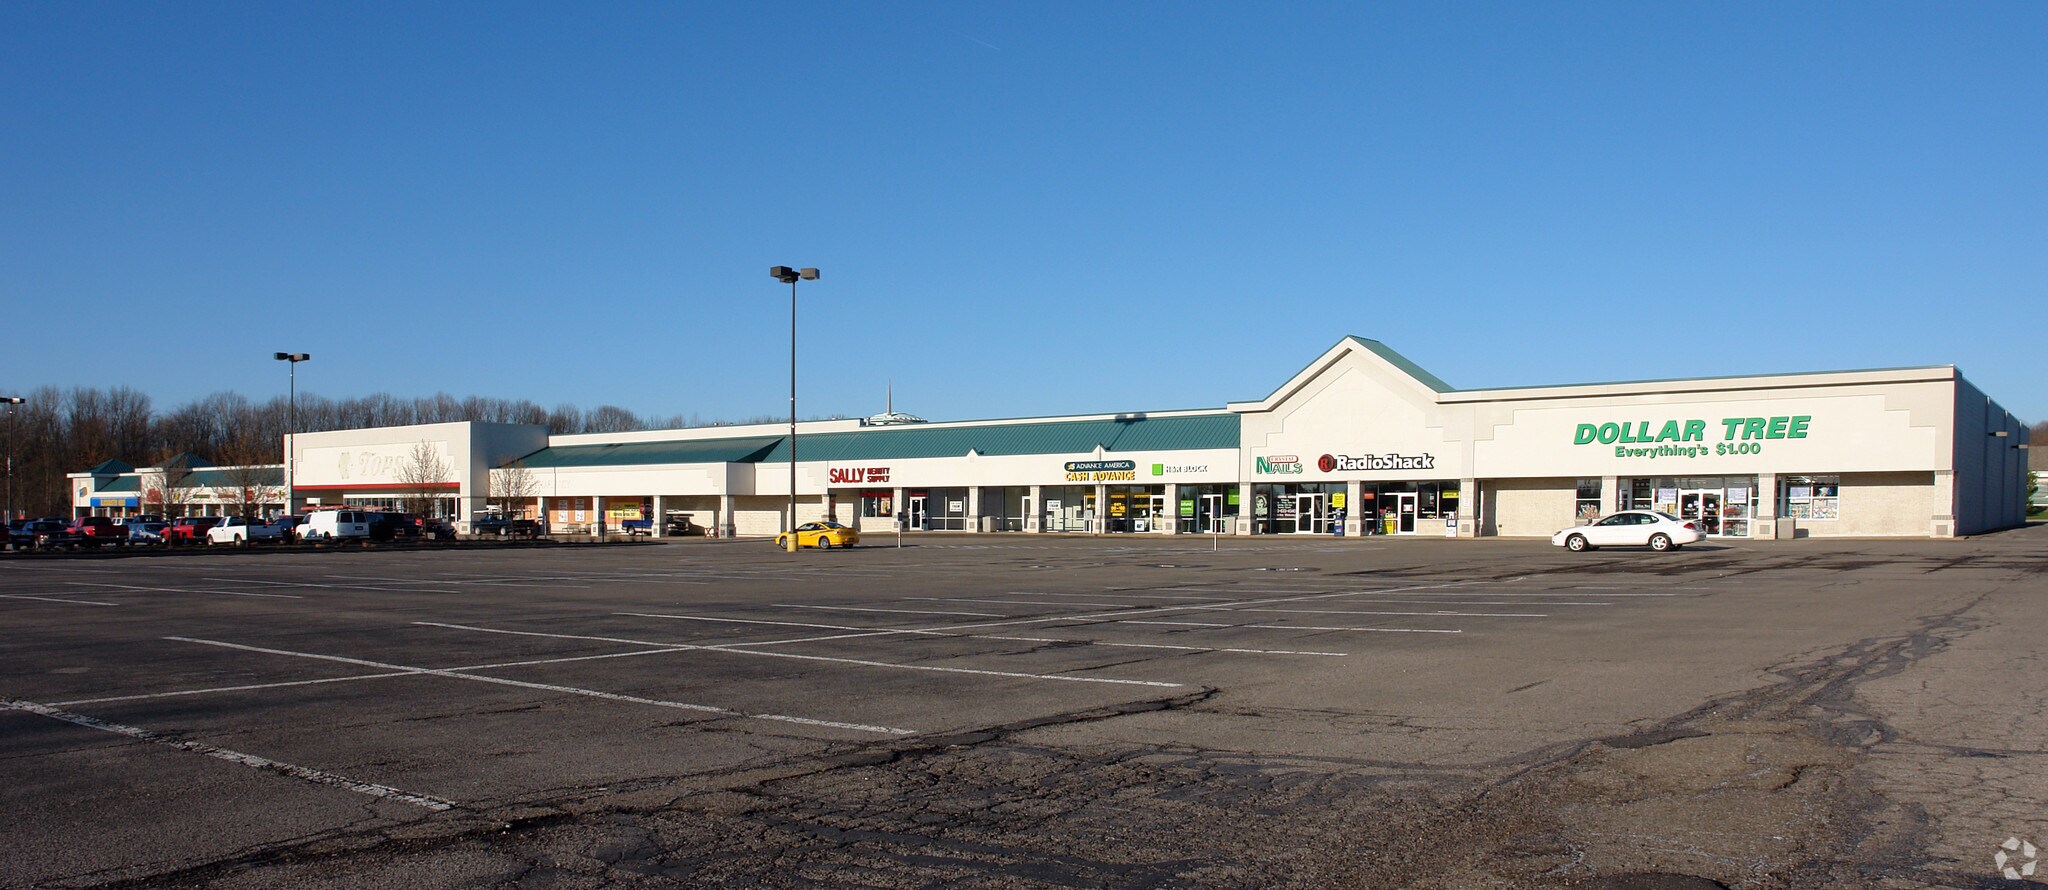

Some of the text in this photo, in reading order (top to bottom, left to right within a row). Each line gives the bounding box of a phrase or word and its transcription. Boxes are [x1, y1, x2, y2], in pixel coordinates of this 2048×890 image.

[1574, 415, 1811, 445] DOLLAR TREE
[1615, 442, 1761, 459] Everything's $1.00
[1184, 465, 1208, 473] BLOCK
[1337, 453, 1434, 470] RadioShack
[829, 468, 865, 484] SALLY
[867, 475, 890, 483] SUPPLY
[1065, 471, 1135, 481] CASH ADVANCE
